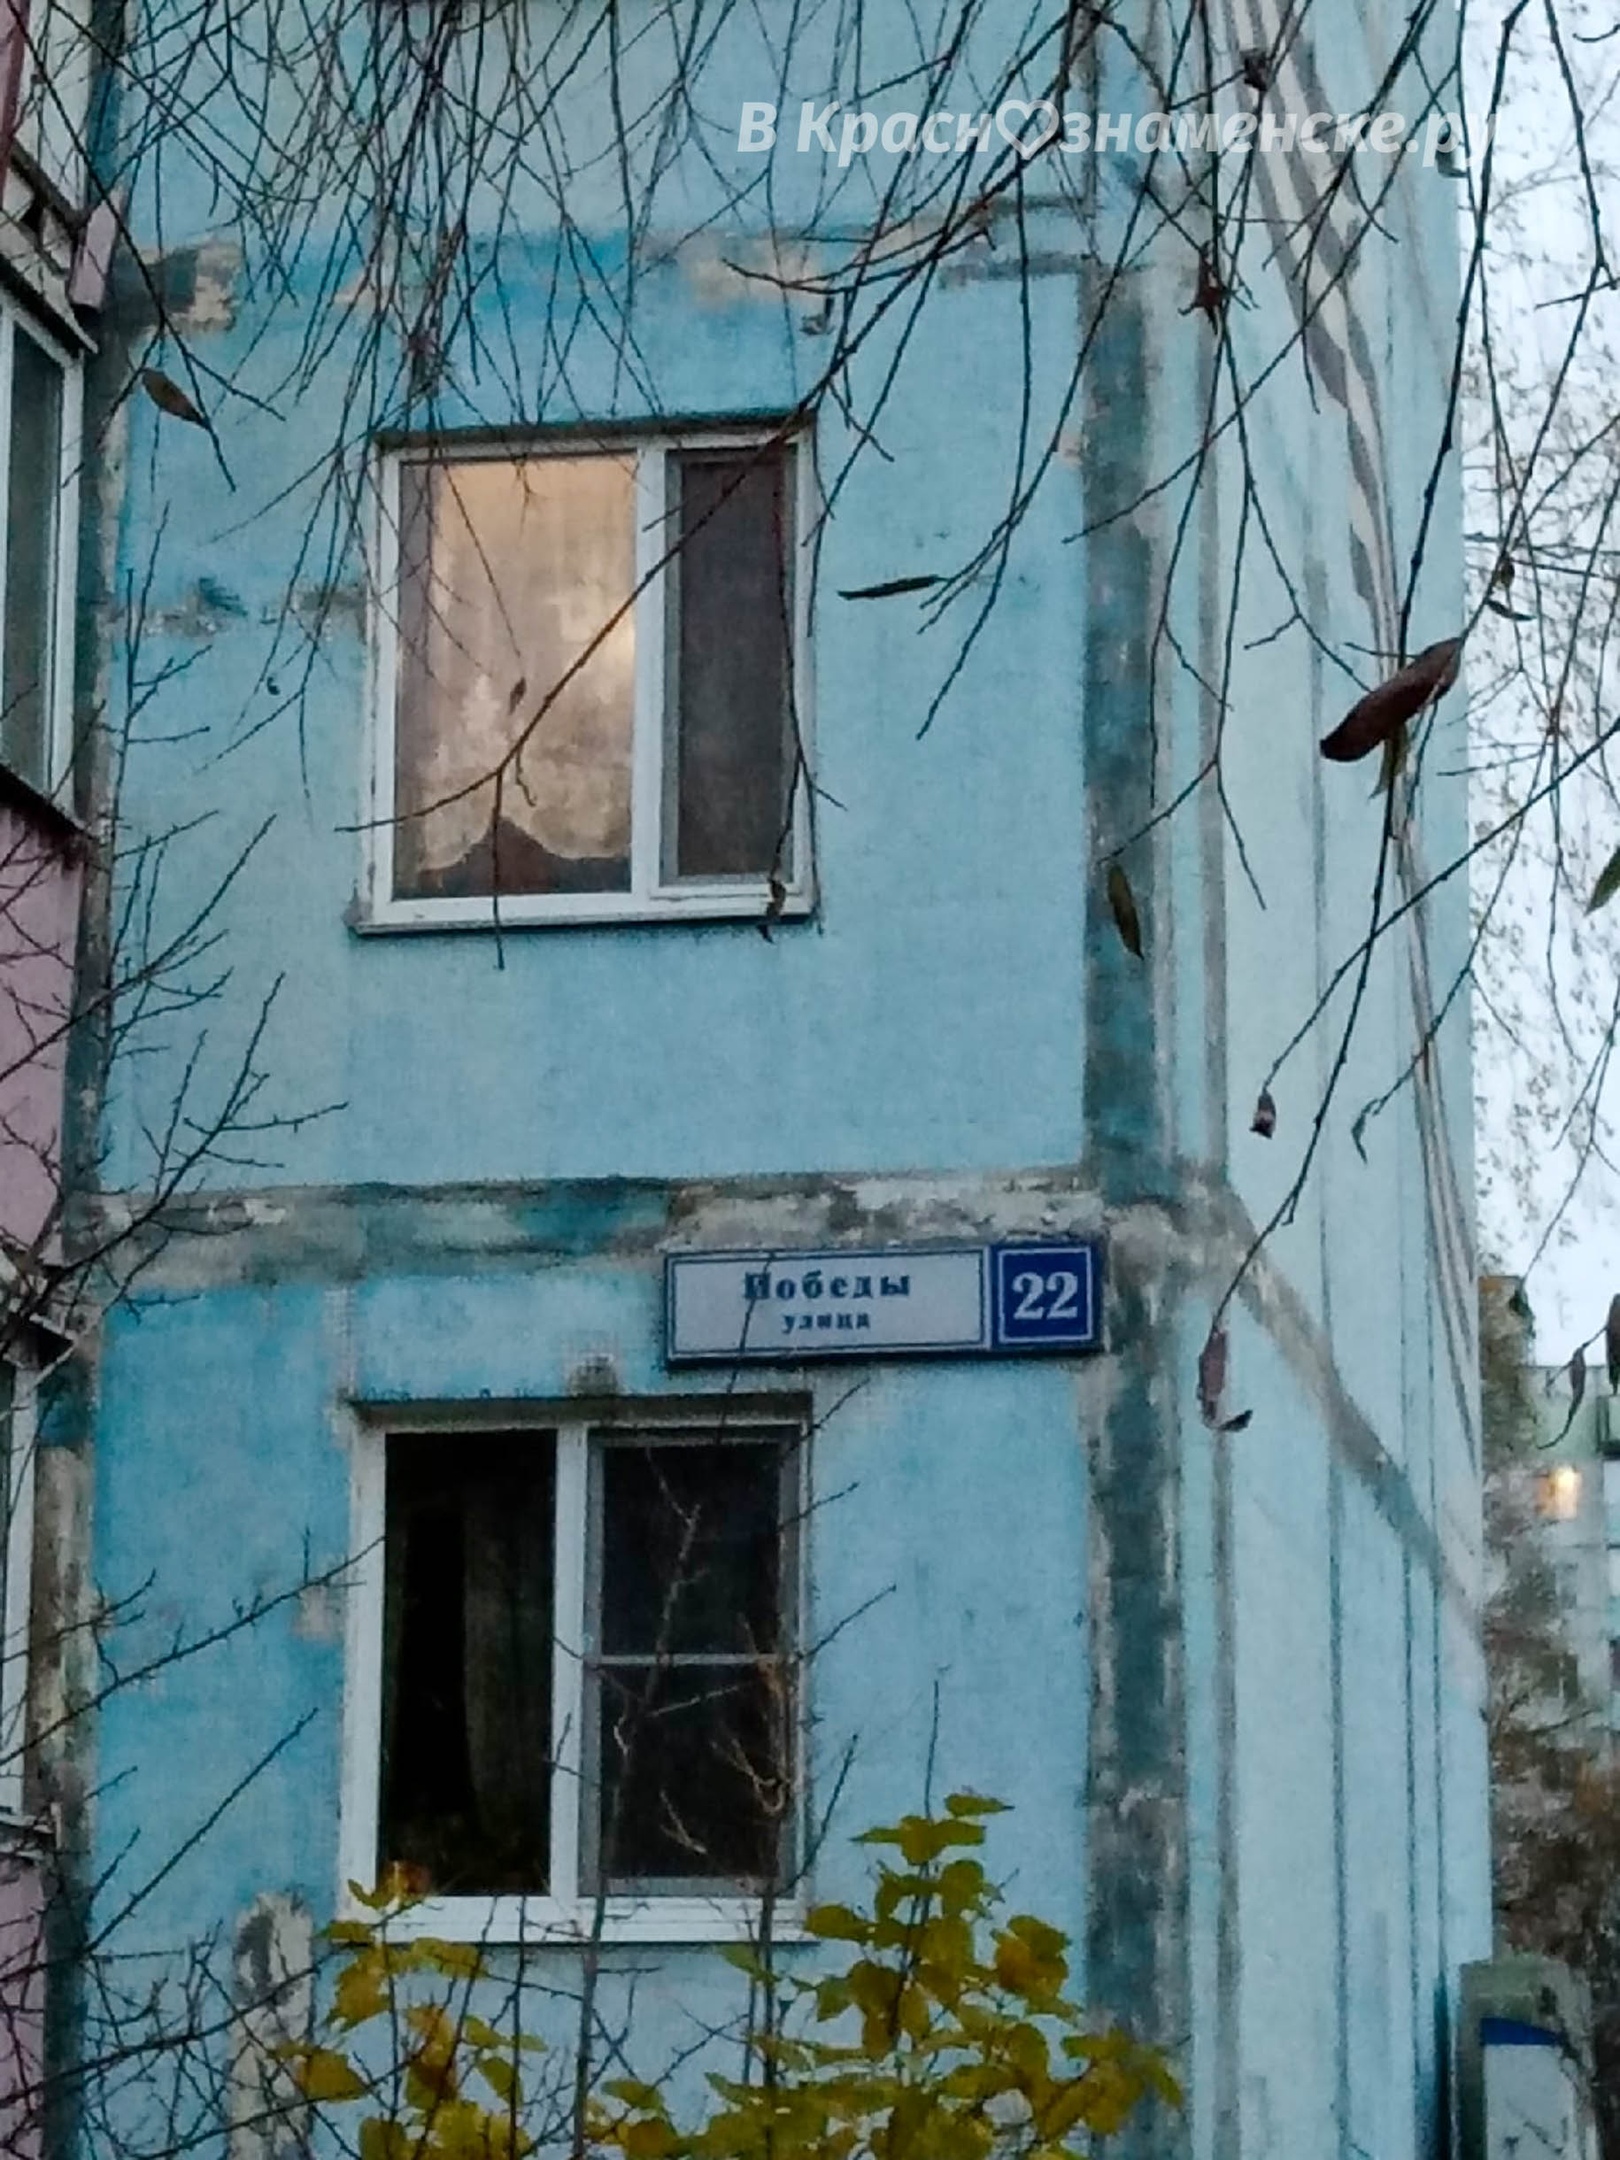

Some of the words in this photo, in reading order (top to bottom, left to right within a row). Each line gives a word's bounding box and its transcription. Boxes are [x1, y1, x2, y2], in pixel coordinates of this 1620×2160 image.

[744, 1270, 910, 1300] Победы
[1012, 1271, 1079, 1320] 22
[781, 1313, 870, 1334] улица
